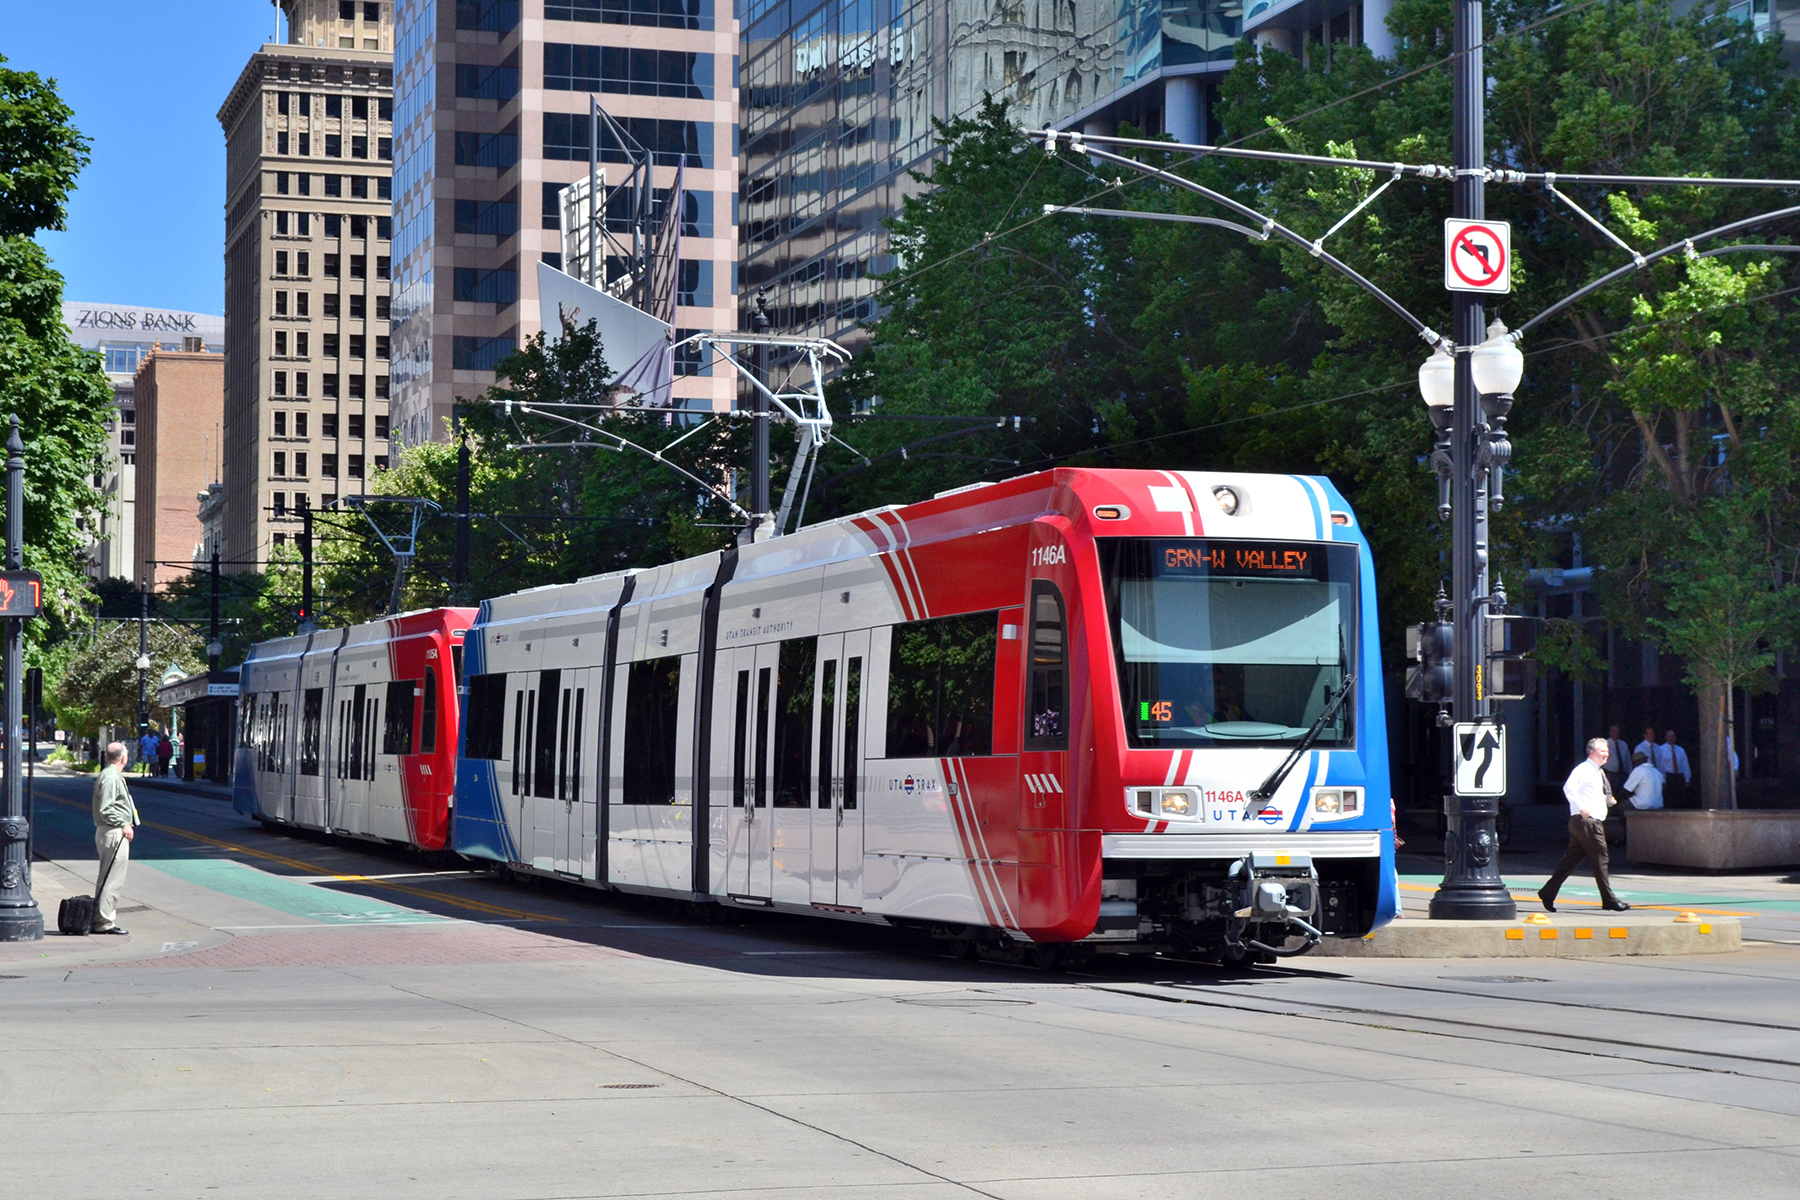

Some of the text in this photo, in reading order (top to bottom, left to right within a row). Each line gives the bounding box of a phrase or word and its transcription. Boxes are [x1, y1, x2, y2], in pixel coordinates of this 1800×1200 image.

[80, 309, 197, 329] ZIONS BANK
[1032, 544, 1066, 567] 1146A
[1165, 548, 1308, 570] GRN-W VALLEY
[725, 621, 794, 640] UTAH TRANSIT AUTHORITY
[1475, 664, 1483, 701] 3093
[1151, 701, 1173, 721] 45
[889, 779, 937, 791] UTA TRAX
[1205, 790, 1244, 803] 1146A
[1213, 809, 1252, 821] UTA
